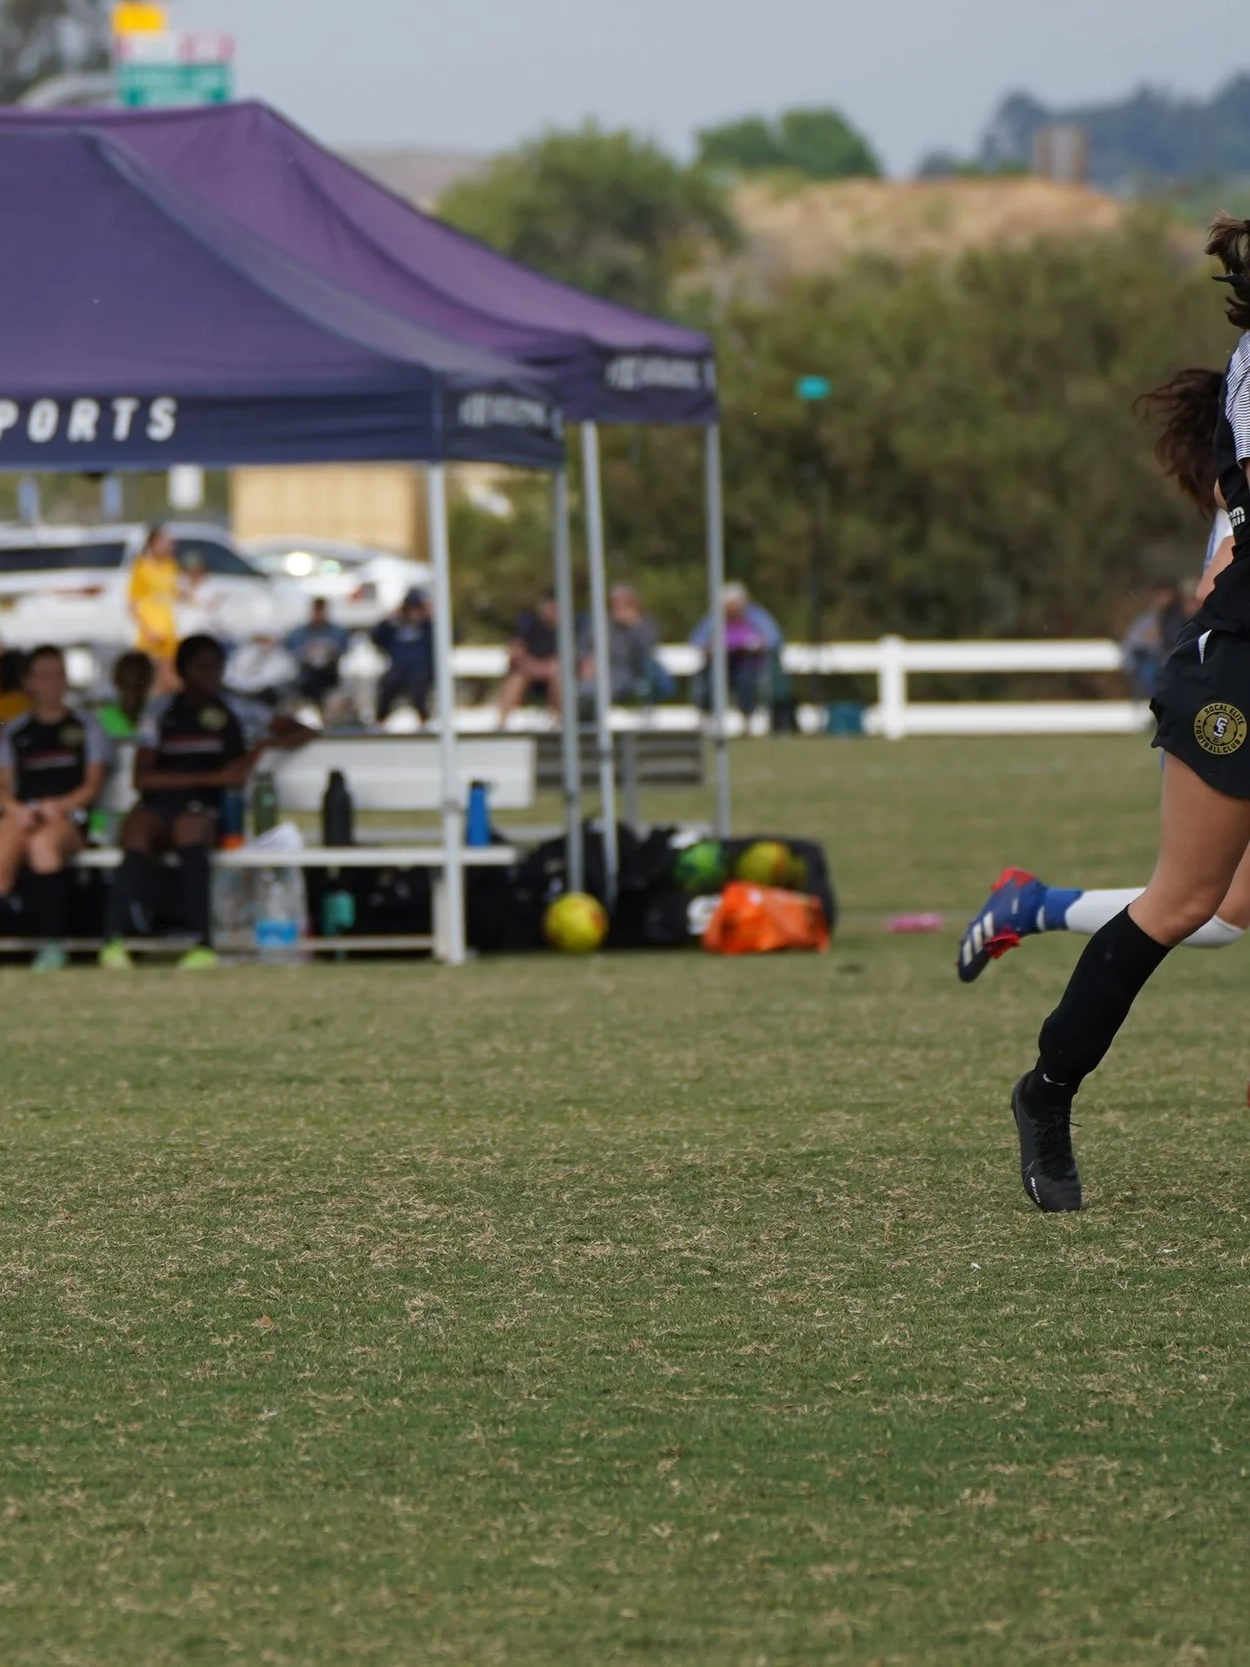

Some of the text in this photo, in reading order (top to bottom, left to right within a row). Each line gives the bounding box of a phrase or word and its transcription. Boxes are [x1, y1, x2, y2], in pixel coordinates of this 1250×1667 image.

[1204, 704, 1245, 725] SOCAL ELITE
[1195, 725, 1241, 753] FOOTBALL CLUB
